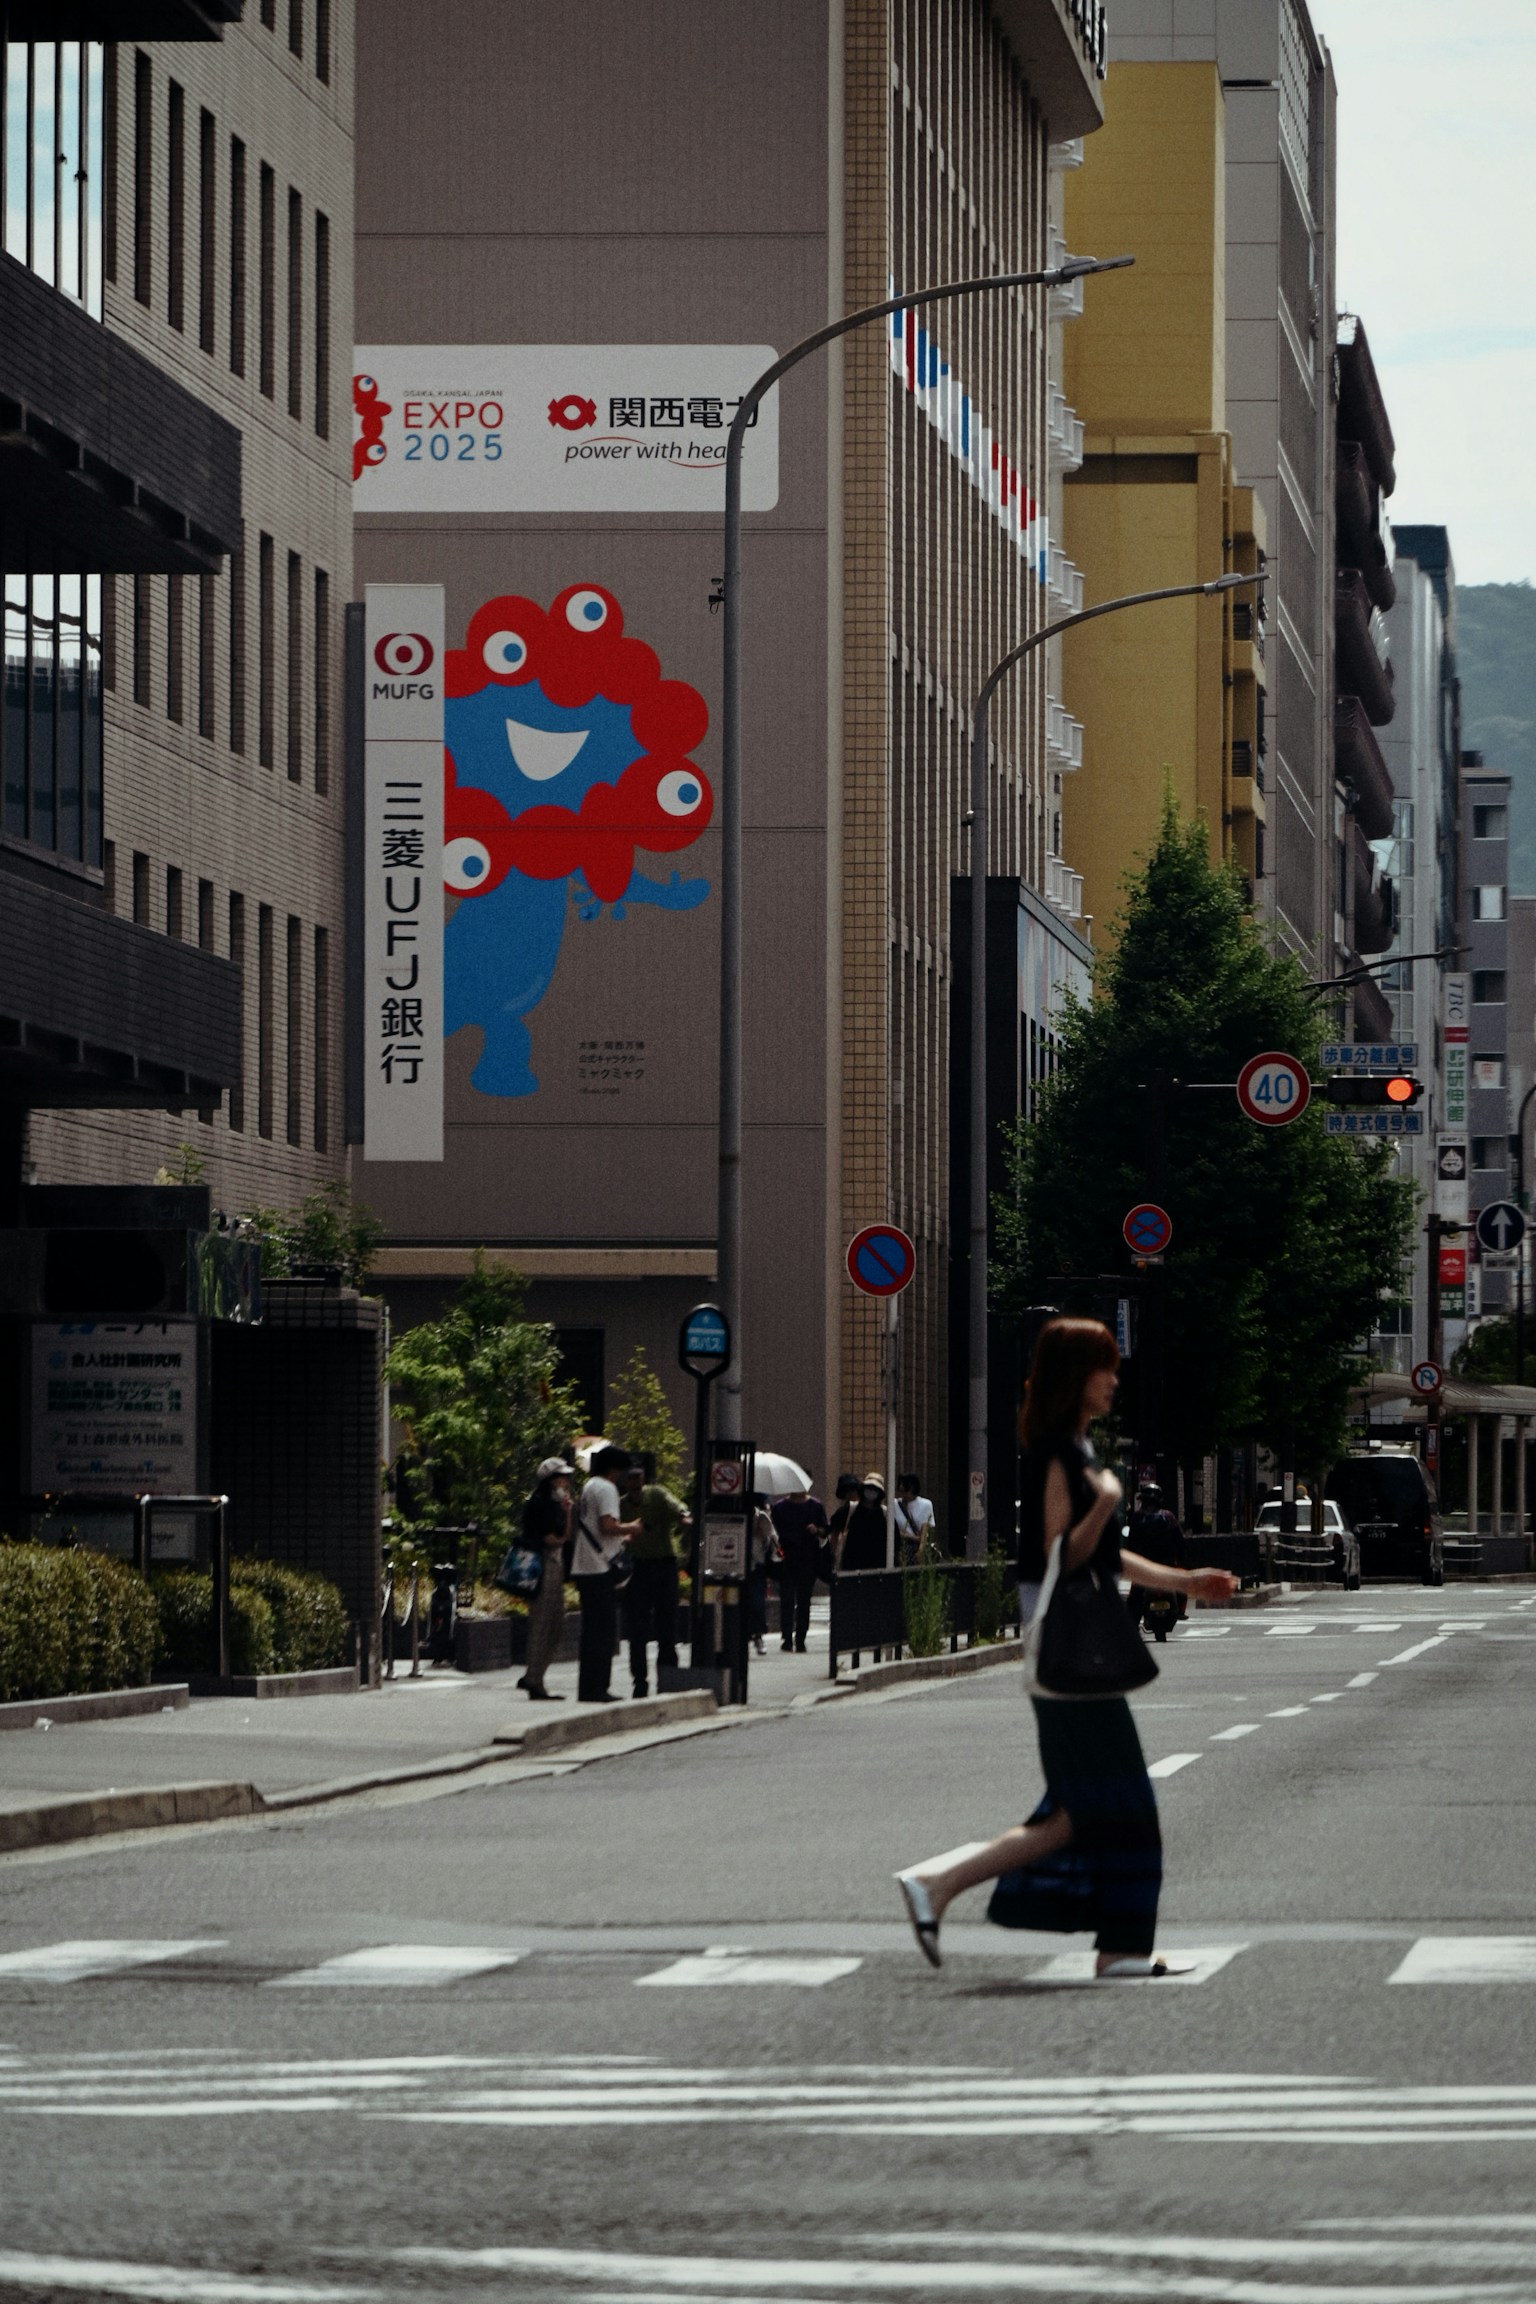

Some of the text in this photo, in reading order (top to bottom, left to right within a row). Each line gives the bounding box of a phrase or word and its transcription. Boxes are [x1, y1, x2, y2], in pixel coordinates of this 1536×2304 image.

[403, 401, 503, 429] EXPO
[404, 433, 502, 461] 2025
[565, 440, 745, 463] power with hea
[373, 684, 434, 700] MUFG
[381, 781, 424, 1085] 三菱UFJ銀行
[1448, 982, 1464, 1020] TBC
[1324, 1047, 1415, 1064] 歩車分離信号
[577, 1067, 645, 1080] ミャクミャク
[1254, 1073, 1294, 1104] 40
[1328, 1115, 1419, 1131] 時差式信号機
